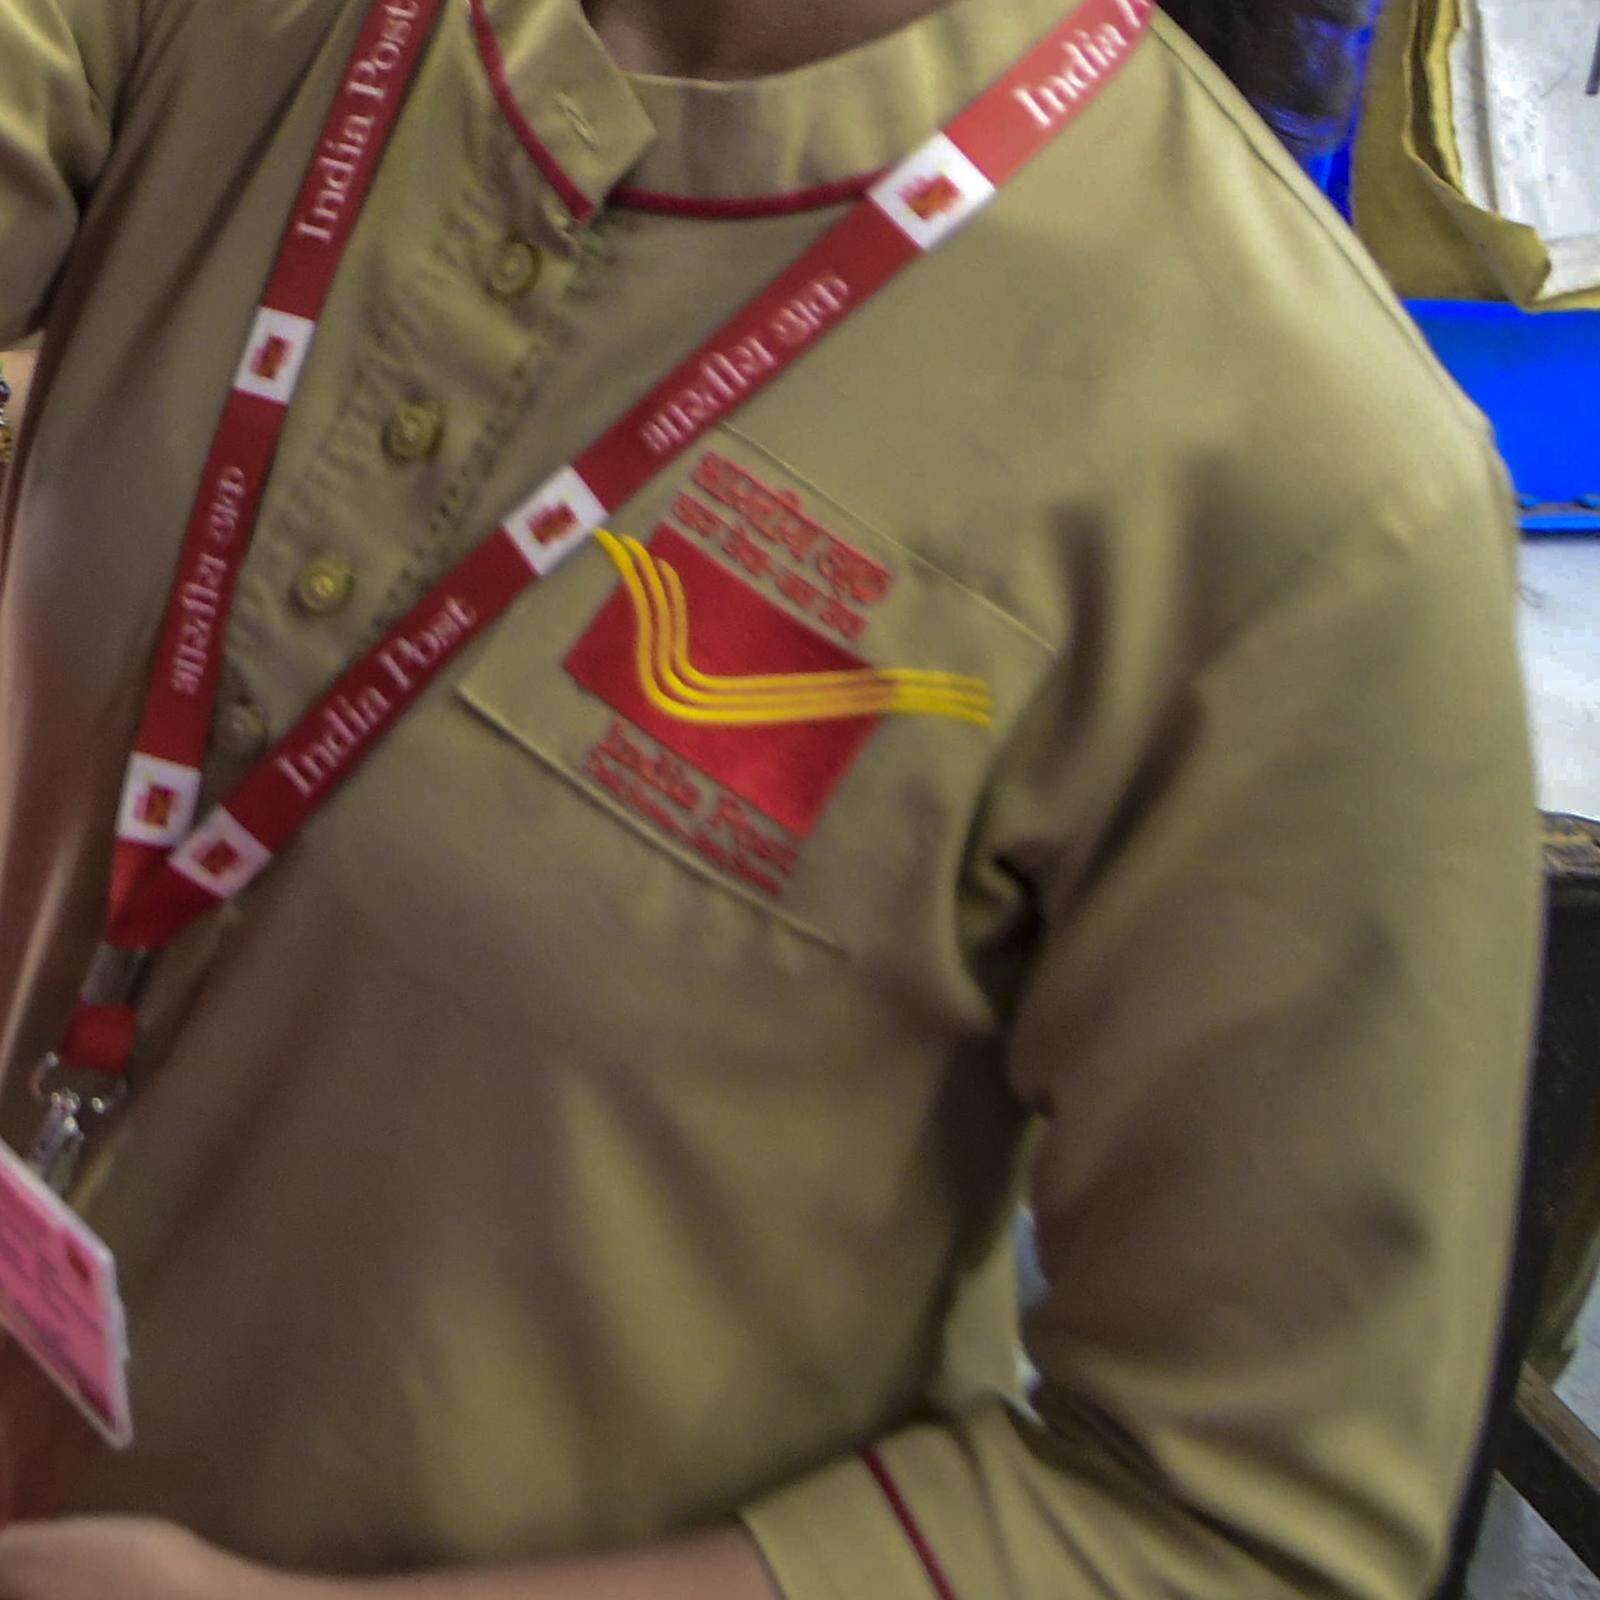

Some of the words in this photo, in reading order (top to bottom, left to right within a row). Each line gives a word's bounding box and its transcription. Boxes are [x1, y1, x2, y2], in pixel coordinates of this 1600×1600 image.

[297, 113, 375, 244] India
[347, 0, 420, 99] Post
[1012, 22, 1128, 128] India
[275, 686, 392, 799] India
[377, 597, 478, 691] Post
